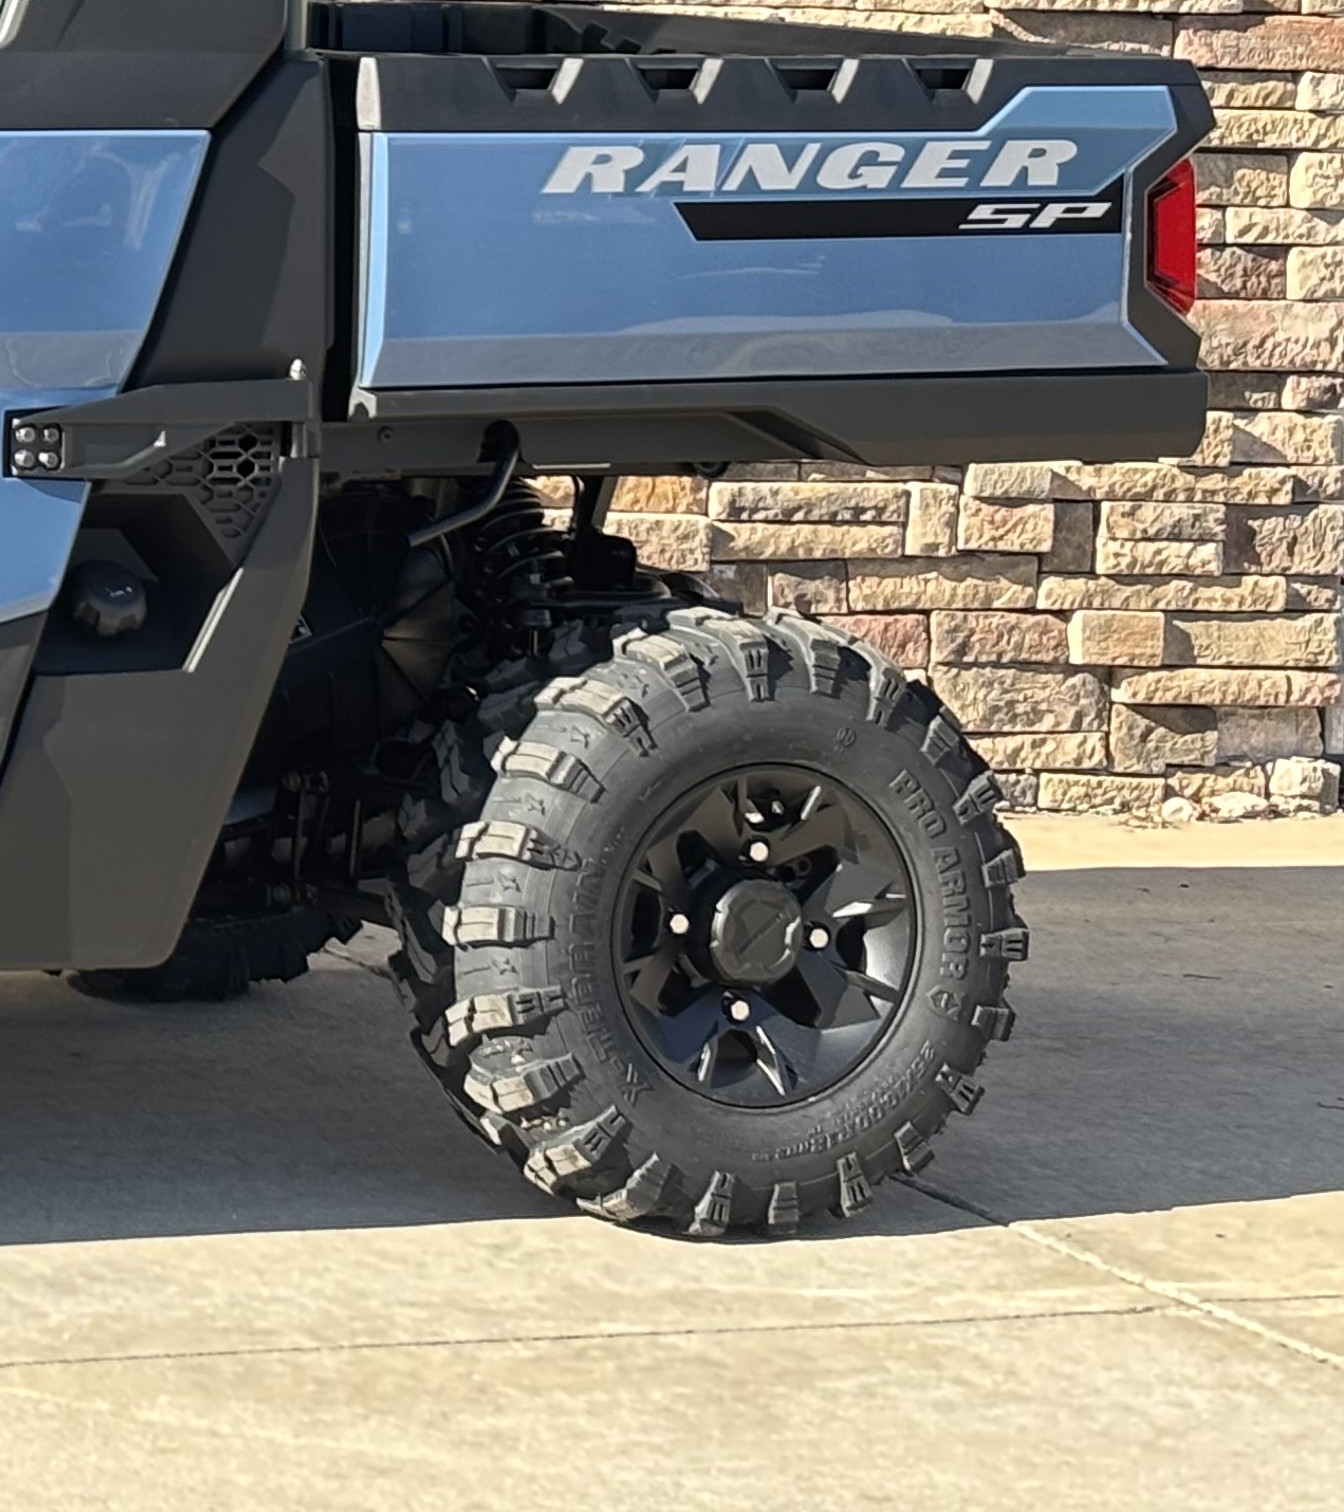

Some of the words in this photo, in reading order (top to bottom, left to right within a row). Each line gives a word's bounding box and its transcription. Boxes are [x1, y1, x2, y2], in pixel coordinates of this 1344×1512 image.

[541, 139, 1079, 195] RANGER
[957, 201, 1113, 230] SP
[888, 768, 947, 839] PRO
[929, 845, 973, 980] ARMOR
[567, 855, 655, 1107] X-TERRAIN
